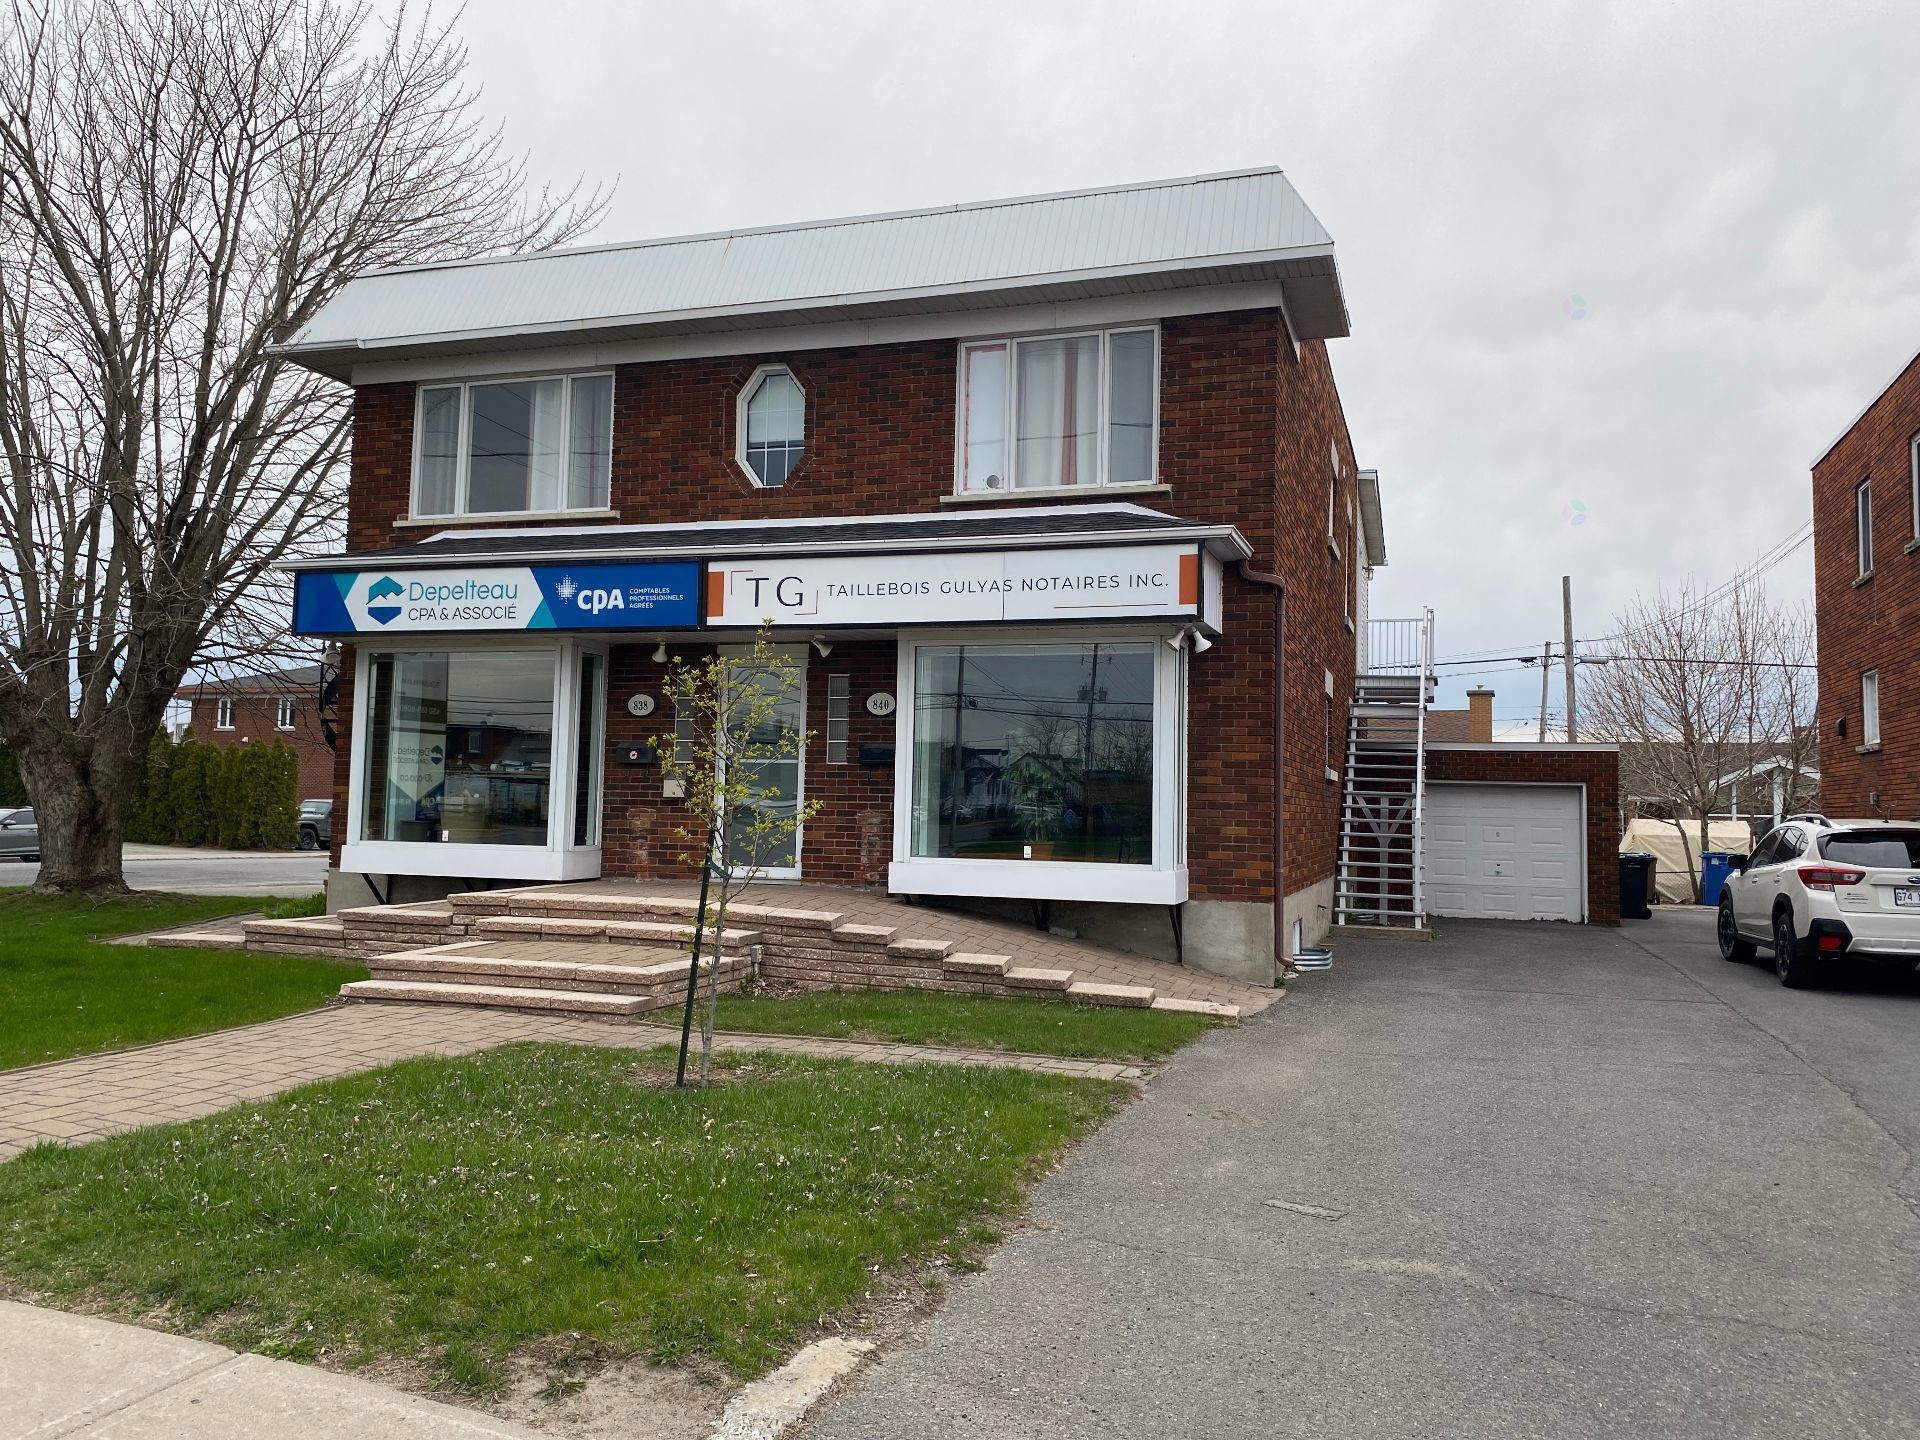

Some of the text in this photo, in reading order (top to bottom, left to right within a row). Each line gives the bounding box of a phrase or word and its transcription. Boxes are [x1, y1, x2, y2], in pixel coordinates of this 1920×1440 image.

[629, 587, 670, 595] COMPTABLES
[745, 576, 804, 608] TG
[827, 572, 1171, 597] TAILLEBOIS GULYAS NOTAIRES INC.
[410, 580, 518, 605] Depelteau
[629, 594, 684, 602] PROFESSIONNELS
[408, 603, 517, 621] CPA & ASSOCIÉ
[633, 700, 649, 711] 838
[872, 699, 890, 711] 840
